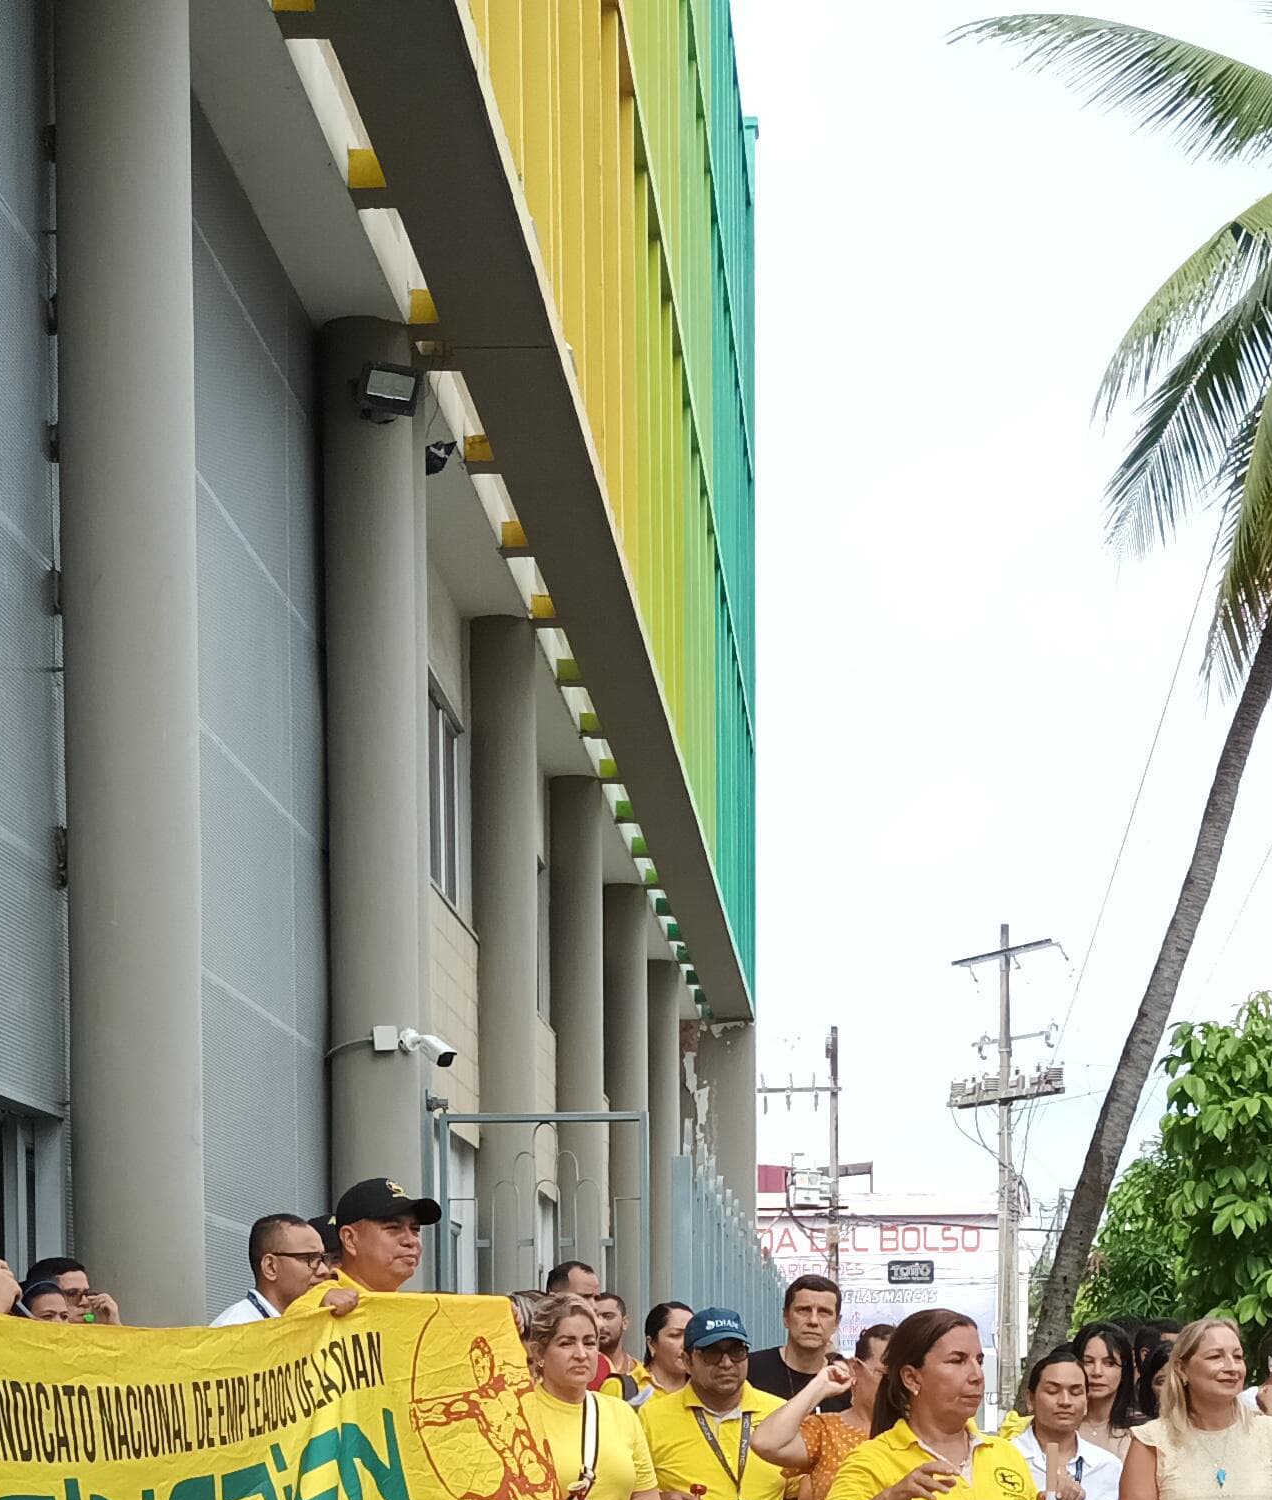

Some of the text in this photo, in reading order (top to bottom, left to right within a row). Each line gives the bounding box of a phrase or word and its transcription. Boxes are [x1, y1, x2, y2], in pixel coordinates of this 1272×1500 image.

[880, 1225, 981, 1252] BOLSO
[96, 1382, 193, 1462] NACIONAL
[191, 1380, 216, 1446] DE
[216, 1365, 298, 1446] EMPLEADOS
